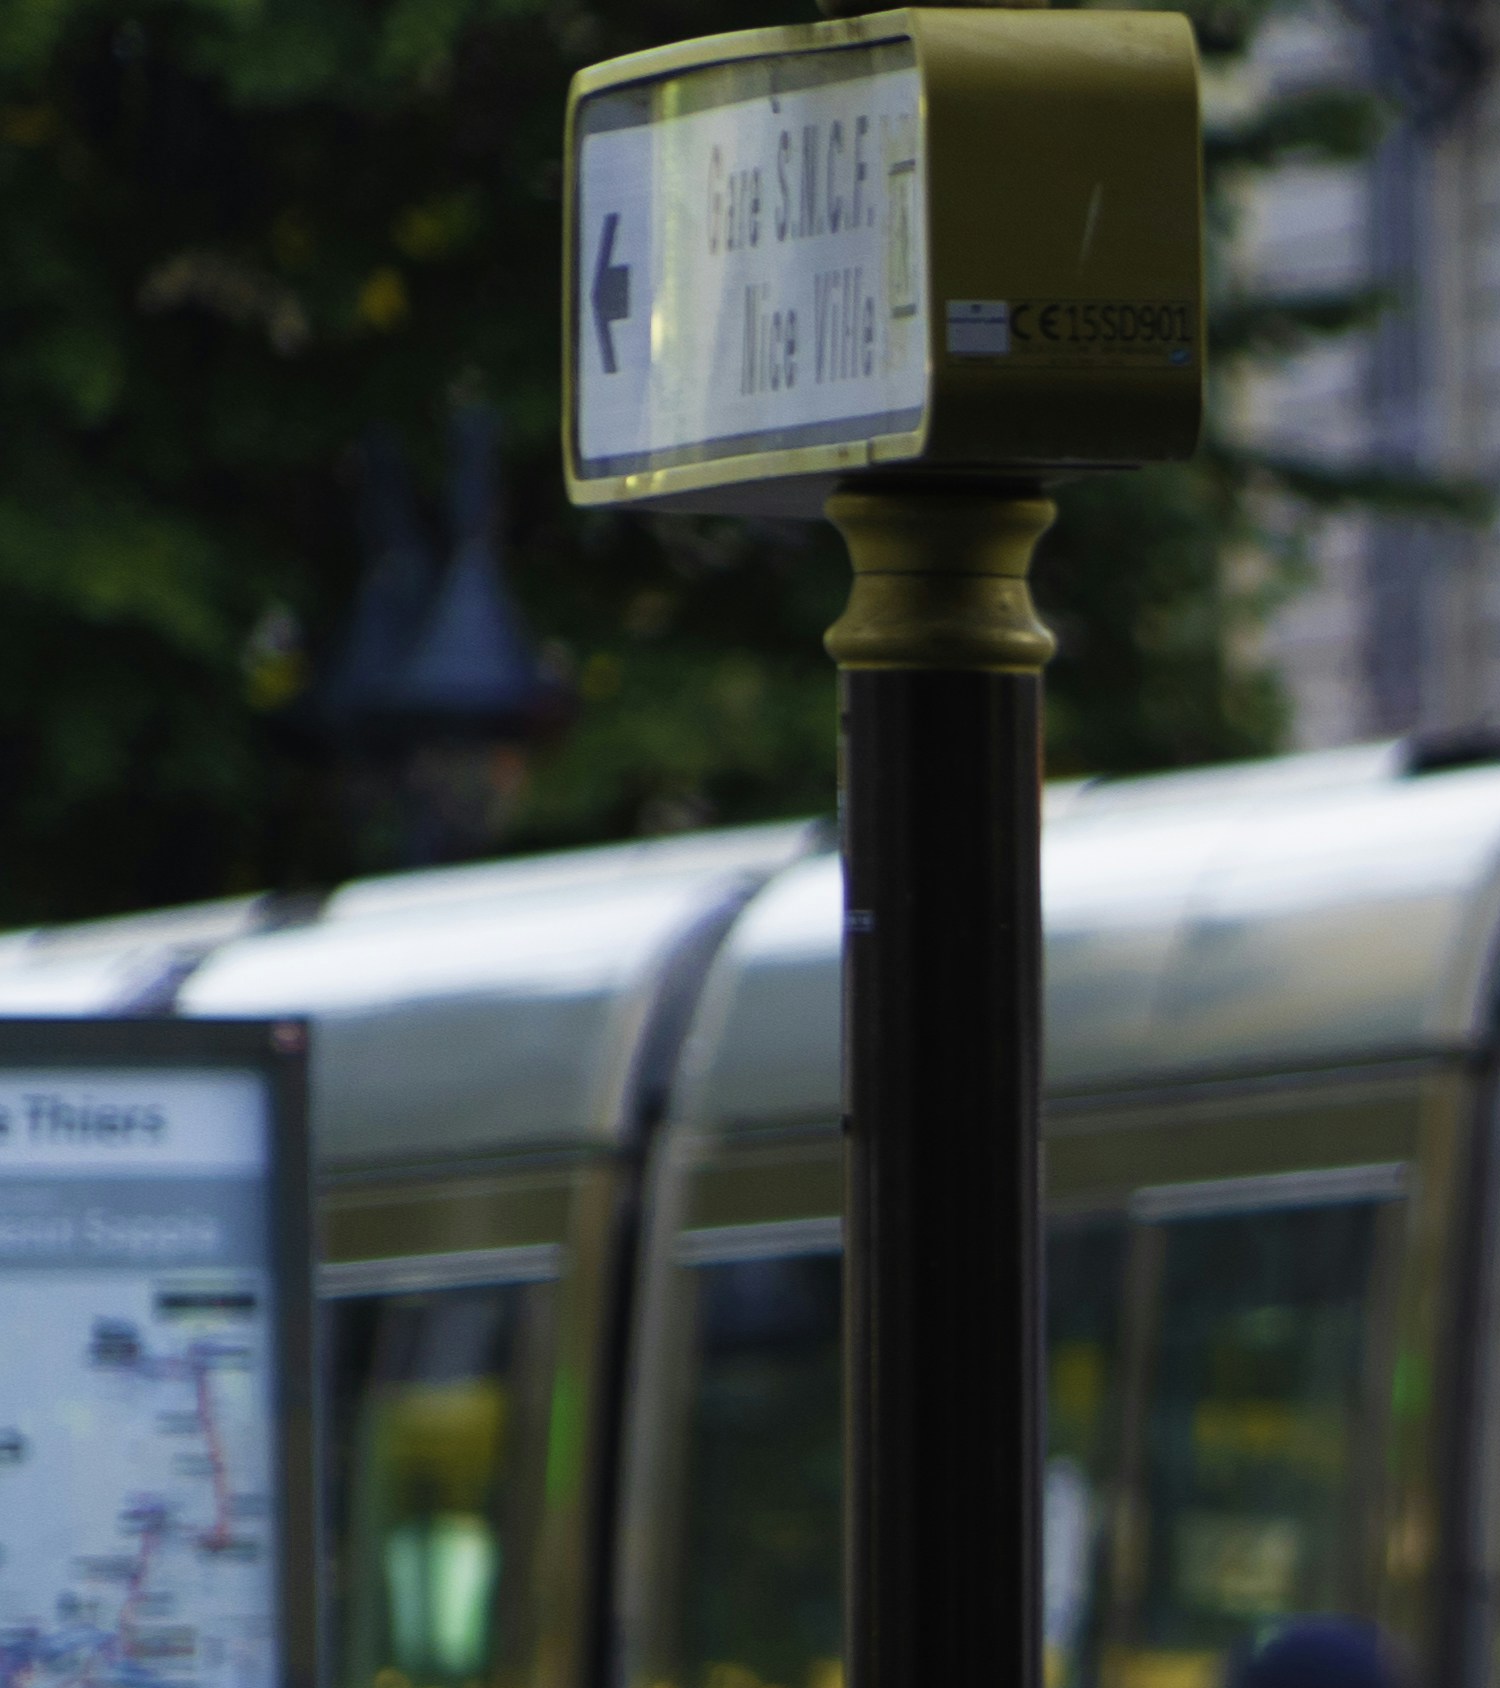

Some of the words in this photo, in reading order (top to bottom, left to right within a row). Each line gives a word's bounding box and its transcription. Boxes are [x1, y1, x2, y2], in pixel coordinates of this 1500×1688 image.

[708, 146, 762, 256] Gare
[774, 114, 875, 242] S.N.C.F.
[740, 281, 798, 396] Nice
[813, 266, 876, 385] Ville
